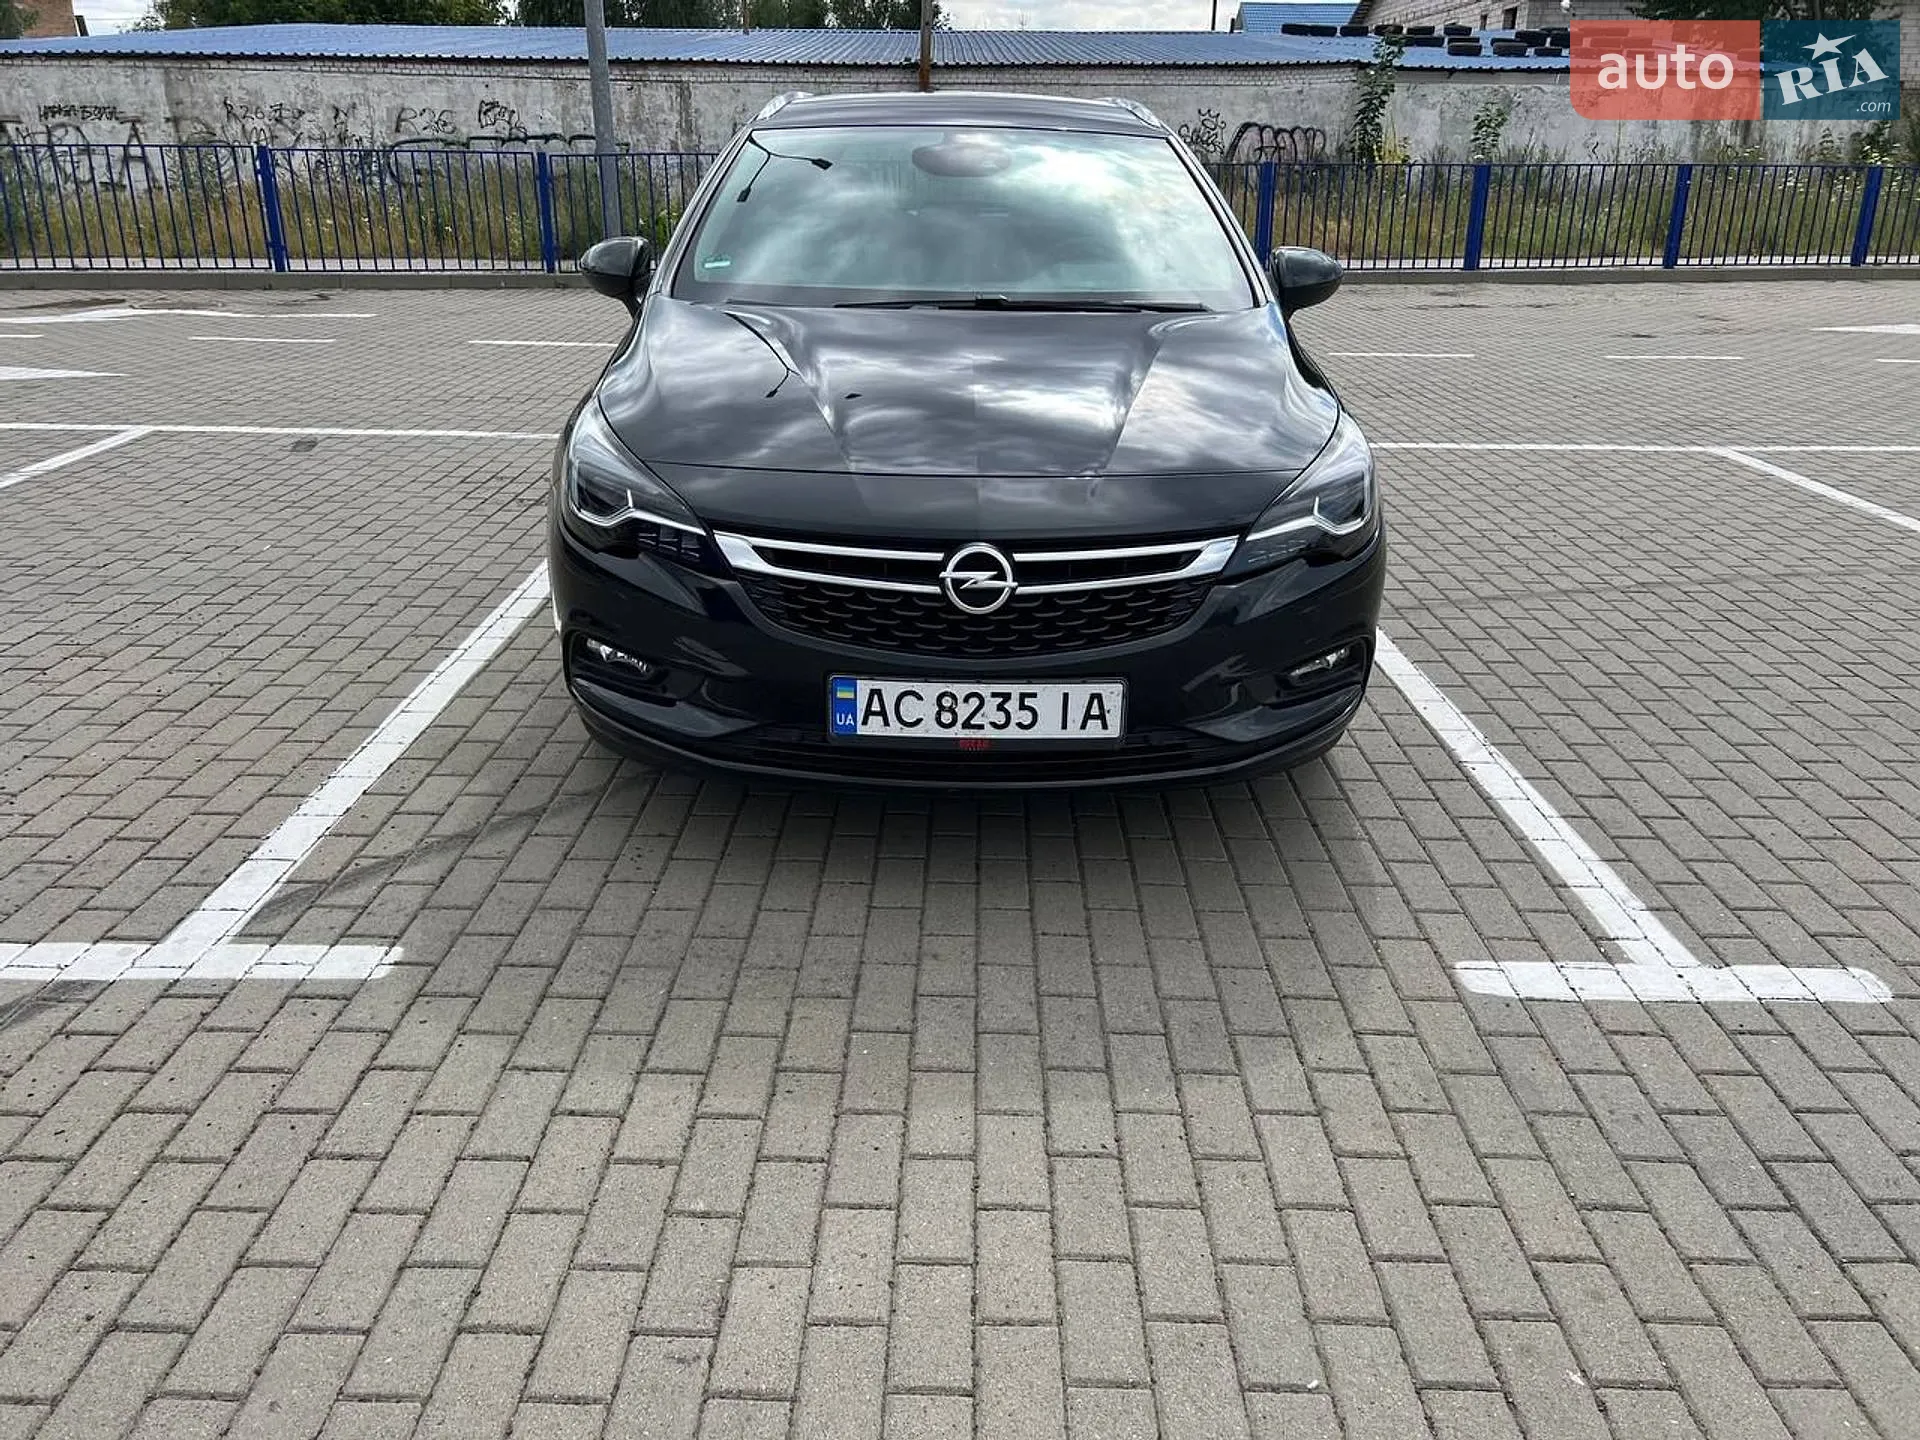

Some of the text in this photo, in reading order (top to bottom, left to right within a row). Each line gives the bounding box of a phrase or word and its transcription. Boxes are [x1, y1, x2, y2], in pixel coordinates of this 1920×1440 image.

[836, 712, 855, 726] UA
[861, 688, 1109, 730] AC 8235 IA
